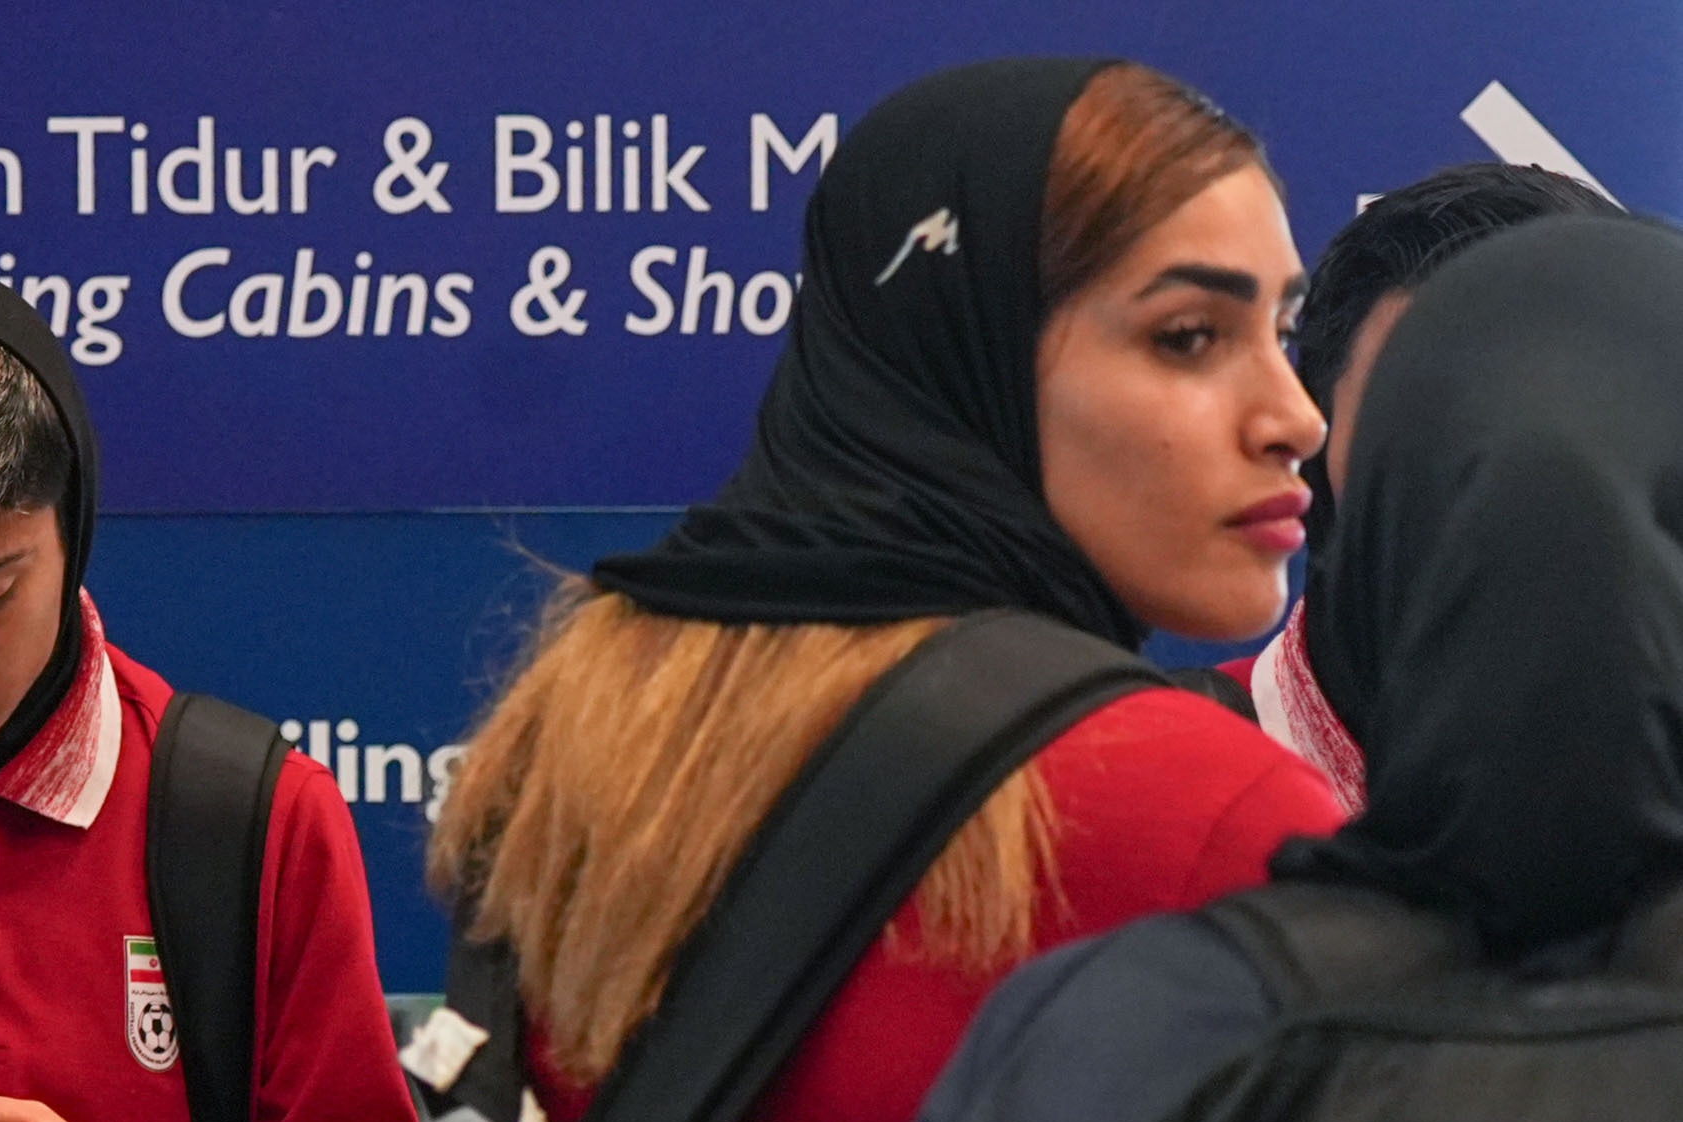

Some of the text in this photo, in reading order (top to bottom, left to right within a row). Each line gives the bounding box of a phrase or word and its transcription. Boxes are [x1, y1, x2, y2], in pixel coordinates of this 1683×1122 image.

[46, 115, 337, 215] Tidur
[373, 116, 452, 214] &
[494, 113, 711, 213] Bilik
[161, 247, 475, 339] Cabins
[509, 245, 589, 337] &
[624, 244, 803, 336] Sho
